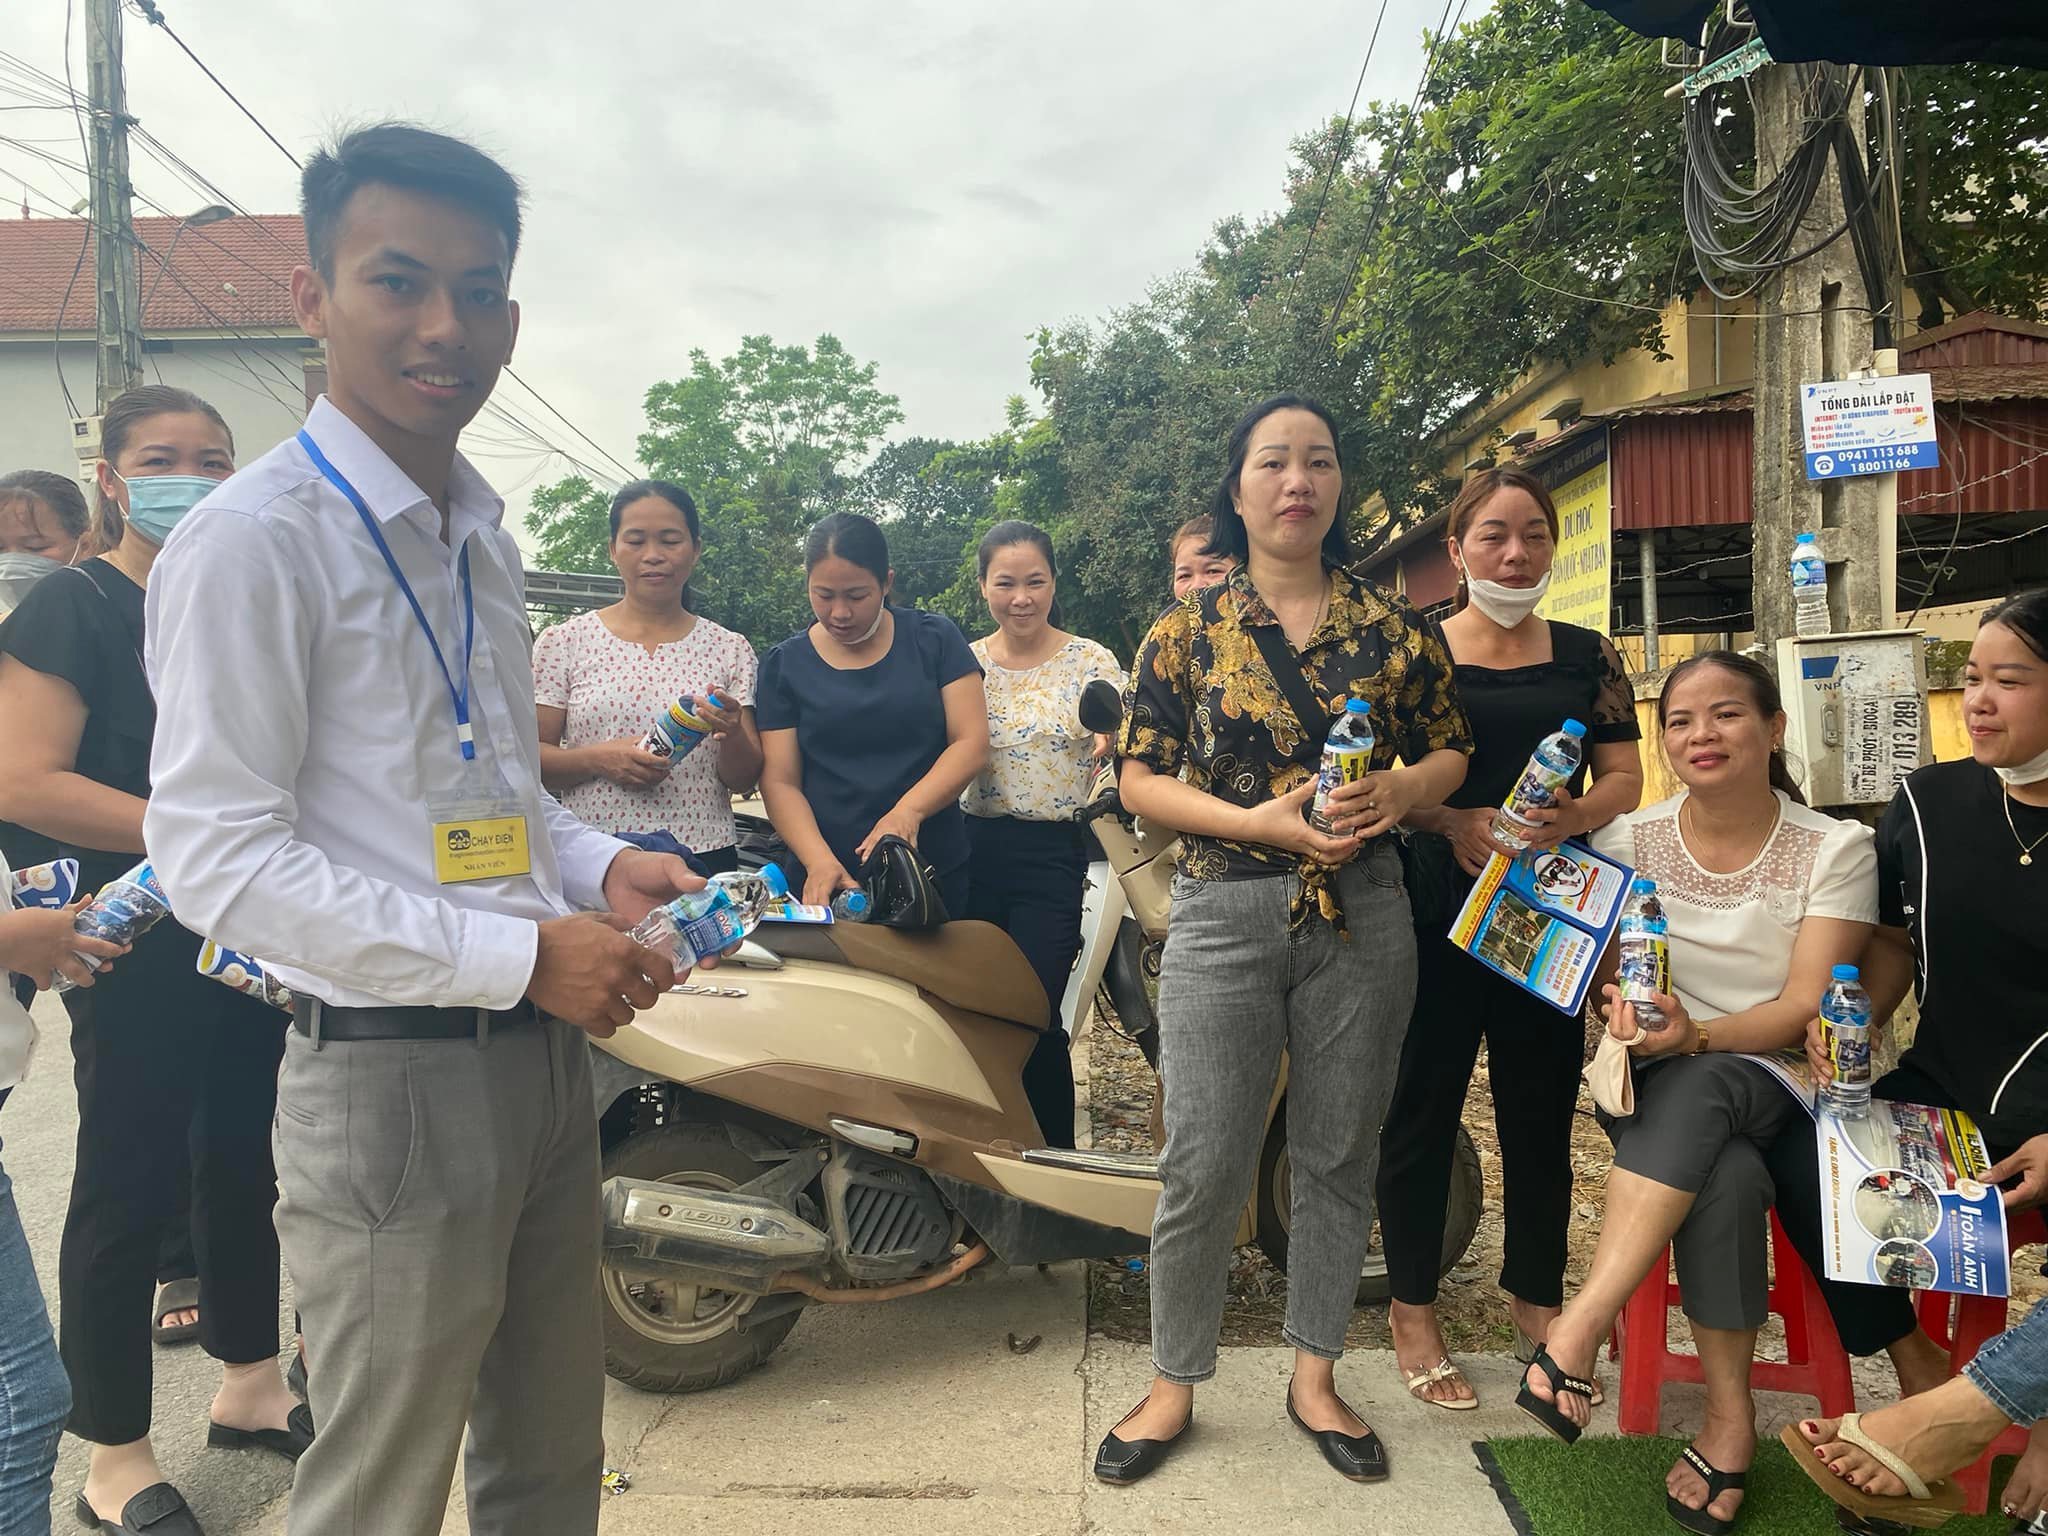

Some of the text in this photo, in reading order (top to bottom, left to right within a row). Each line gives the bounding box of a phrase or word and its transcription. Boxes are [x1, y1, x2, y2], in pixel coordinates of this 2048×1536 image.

[1821, 390, 1916, 411] TỔNG ĐÀI LẮP ĐẶT
[1814, 414, 1838, 422] INTERNET
[1862, 409, 1889, 418] VINAPHONE
[1838, 445, 1919, 462] 0941 113 688
[1851, 459, 1911, 473] 18001166
[1564, 513, 1575, 541] DU
[1814, 681, 1842, 692] VNP
[1862, 700, 1879, 731] BIOGA
[1893, 700, 1918, 729] 289
[1892, 732, 1917, 760] 013
[671, 983, 748, 998] EAD
[682, 1209, 731, 1226] LEAD
[1960, 1214, 1978, 1289] TOÀN ANH
